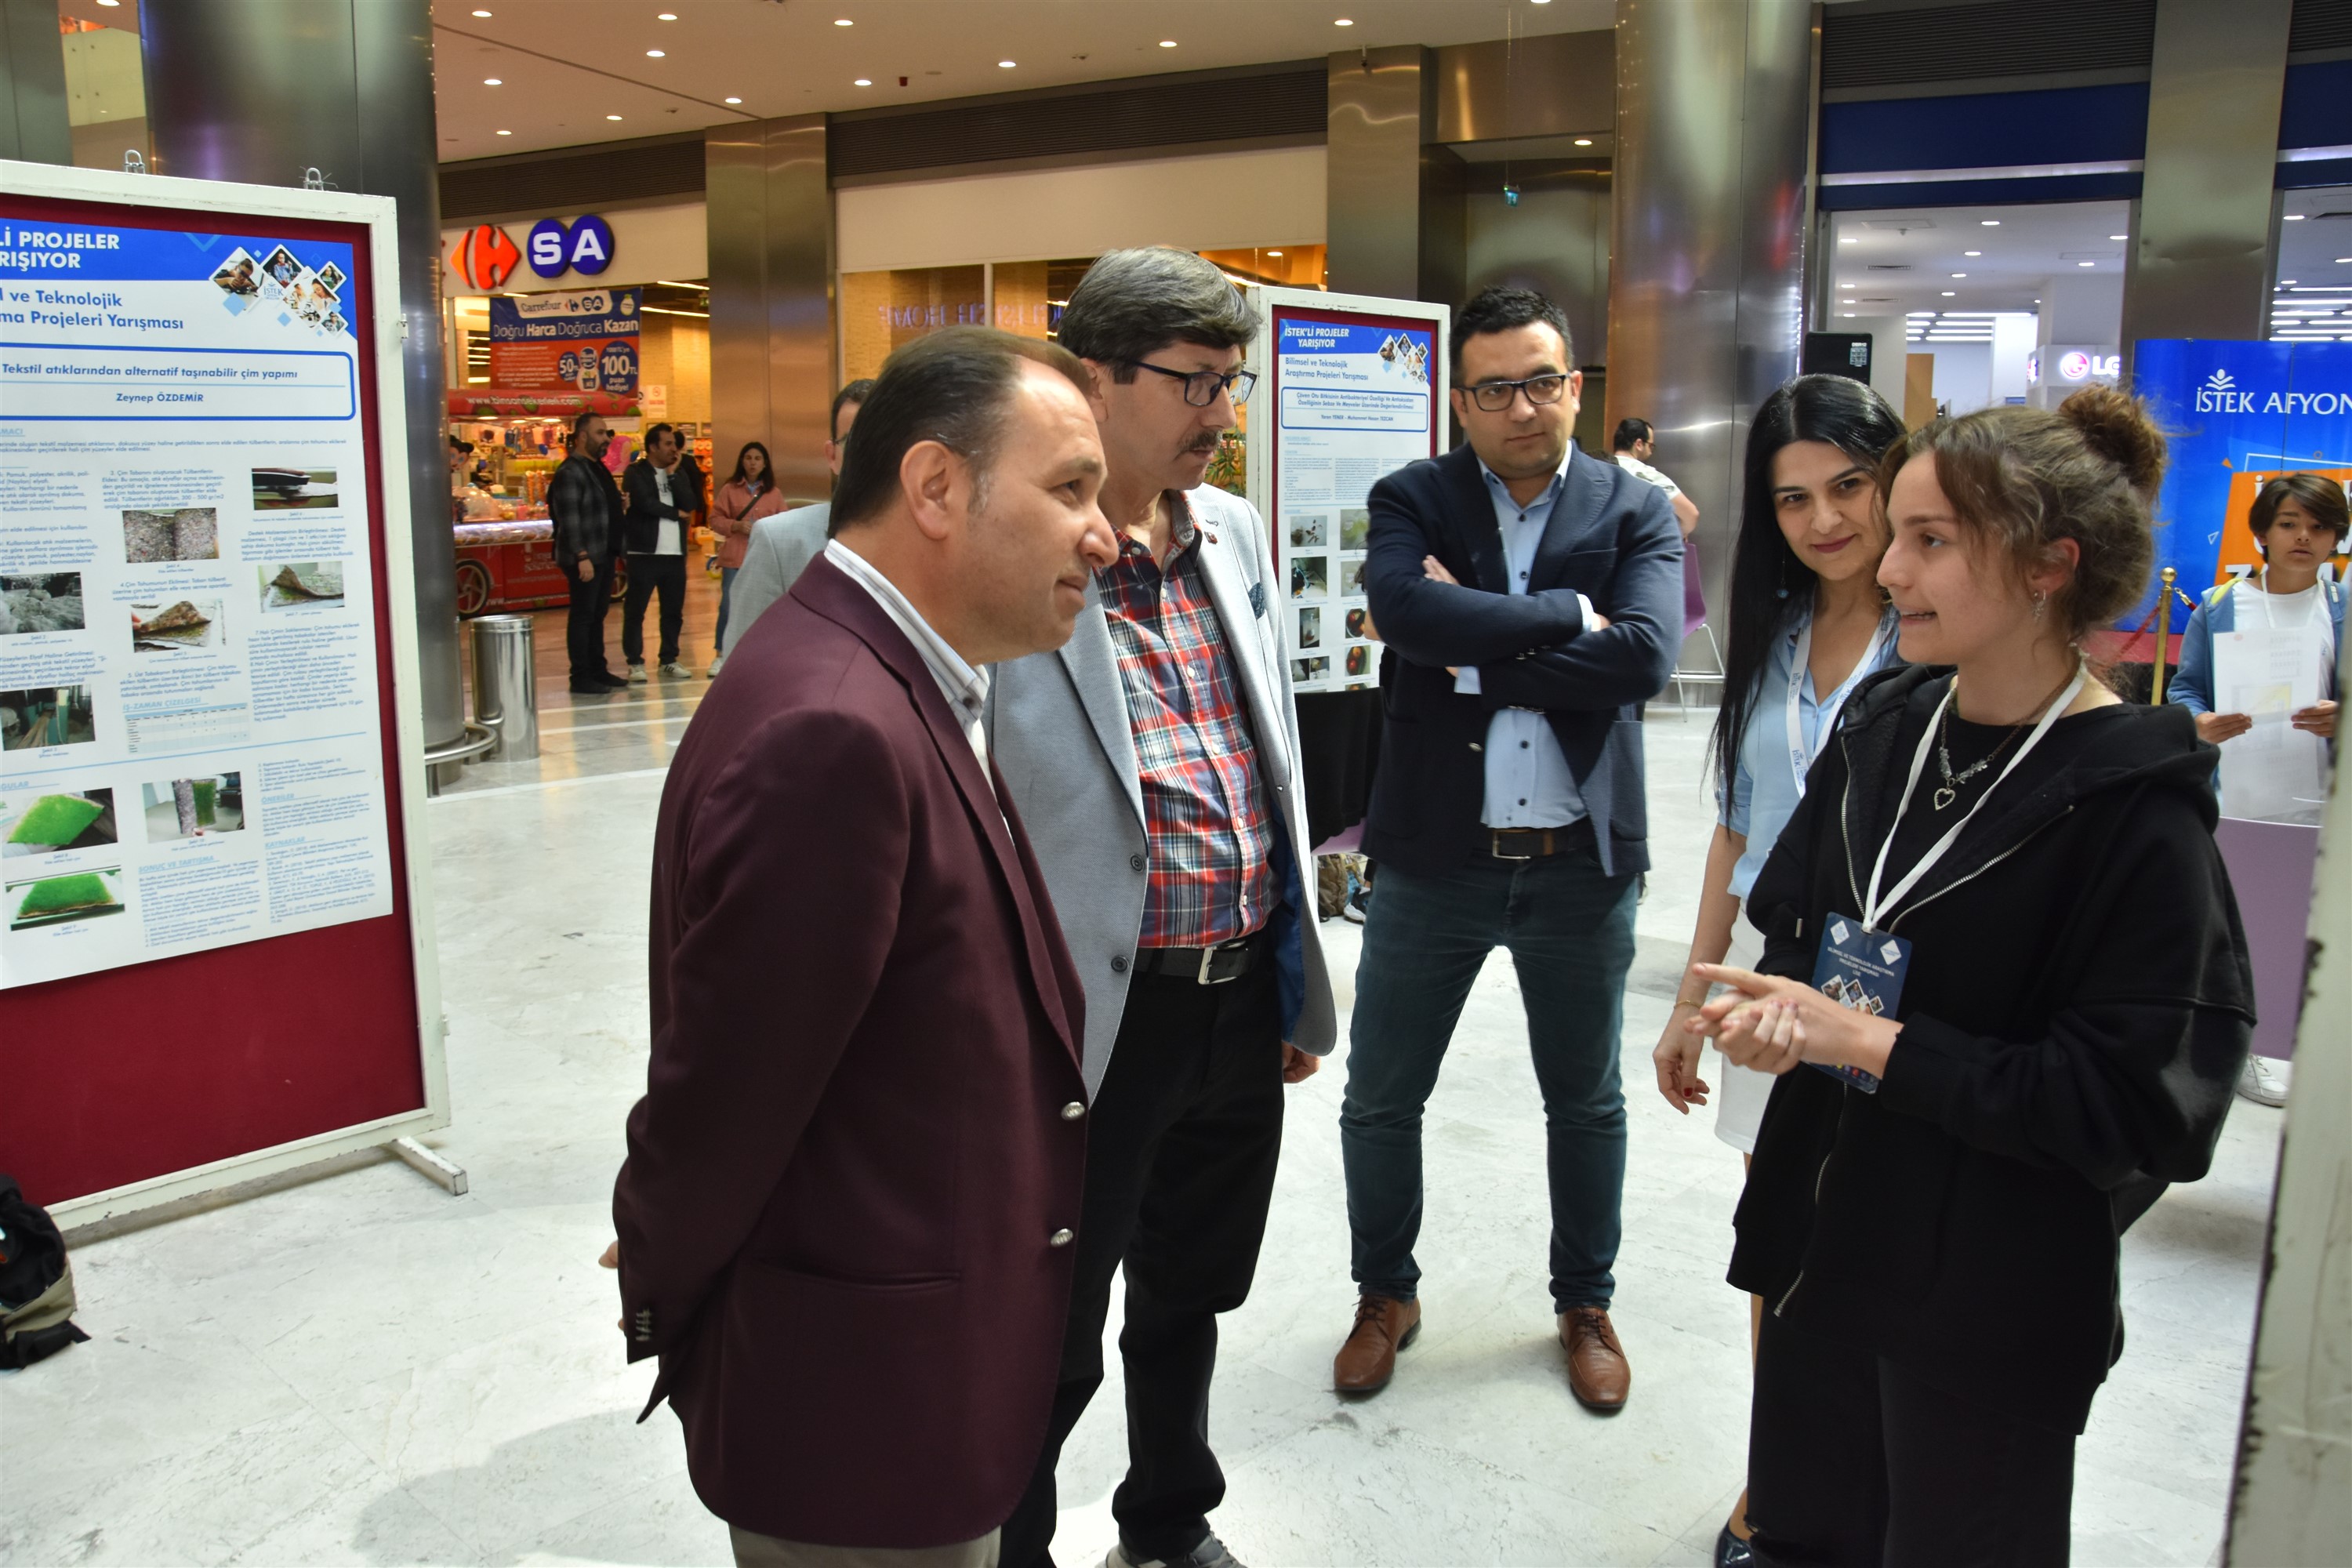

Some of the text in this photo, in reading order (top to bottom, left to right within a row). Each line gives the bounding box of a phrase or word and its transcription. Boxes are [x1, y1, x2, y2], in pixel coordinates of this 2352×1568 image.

[19, 231, 120, 250] PROJELER
[532, 228, 605, 265] SA
[9, 292, 30, 303] ve
[35, 290, 123, 309] Teknolojik
[31, 311, 103, 328] Projeleri
[107, 314, 183, 331] Yarışması
[494, 319, 639, 339] Doğru Harca Doğruca Kazan
[1316, 328, 1349, 337] PROJELER
[1298, 339, 1335, 350] YARIŞIYOR
[2, 364, 298, 379] Tekstil atıklarından alternatif taşınabilir çim yapımı
[560, 359, 575, 374] 50
[601, 355, 630, 376] 100
[1319, 359, 1348, 369] Teknolojik
[1285, 368, 1369, 381] Araştırma Projeleri Yarışması
[116, 392, 204, 403] Zeynep ÖZDEMİR
[2195, 387, 2255, 413] İSTEK
